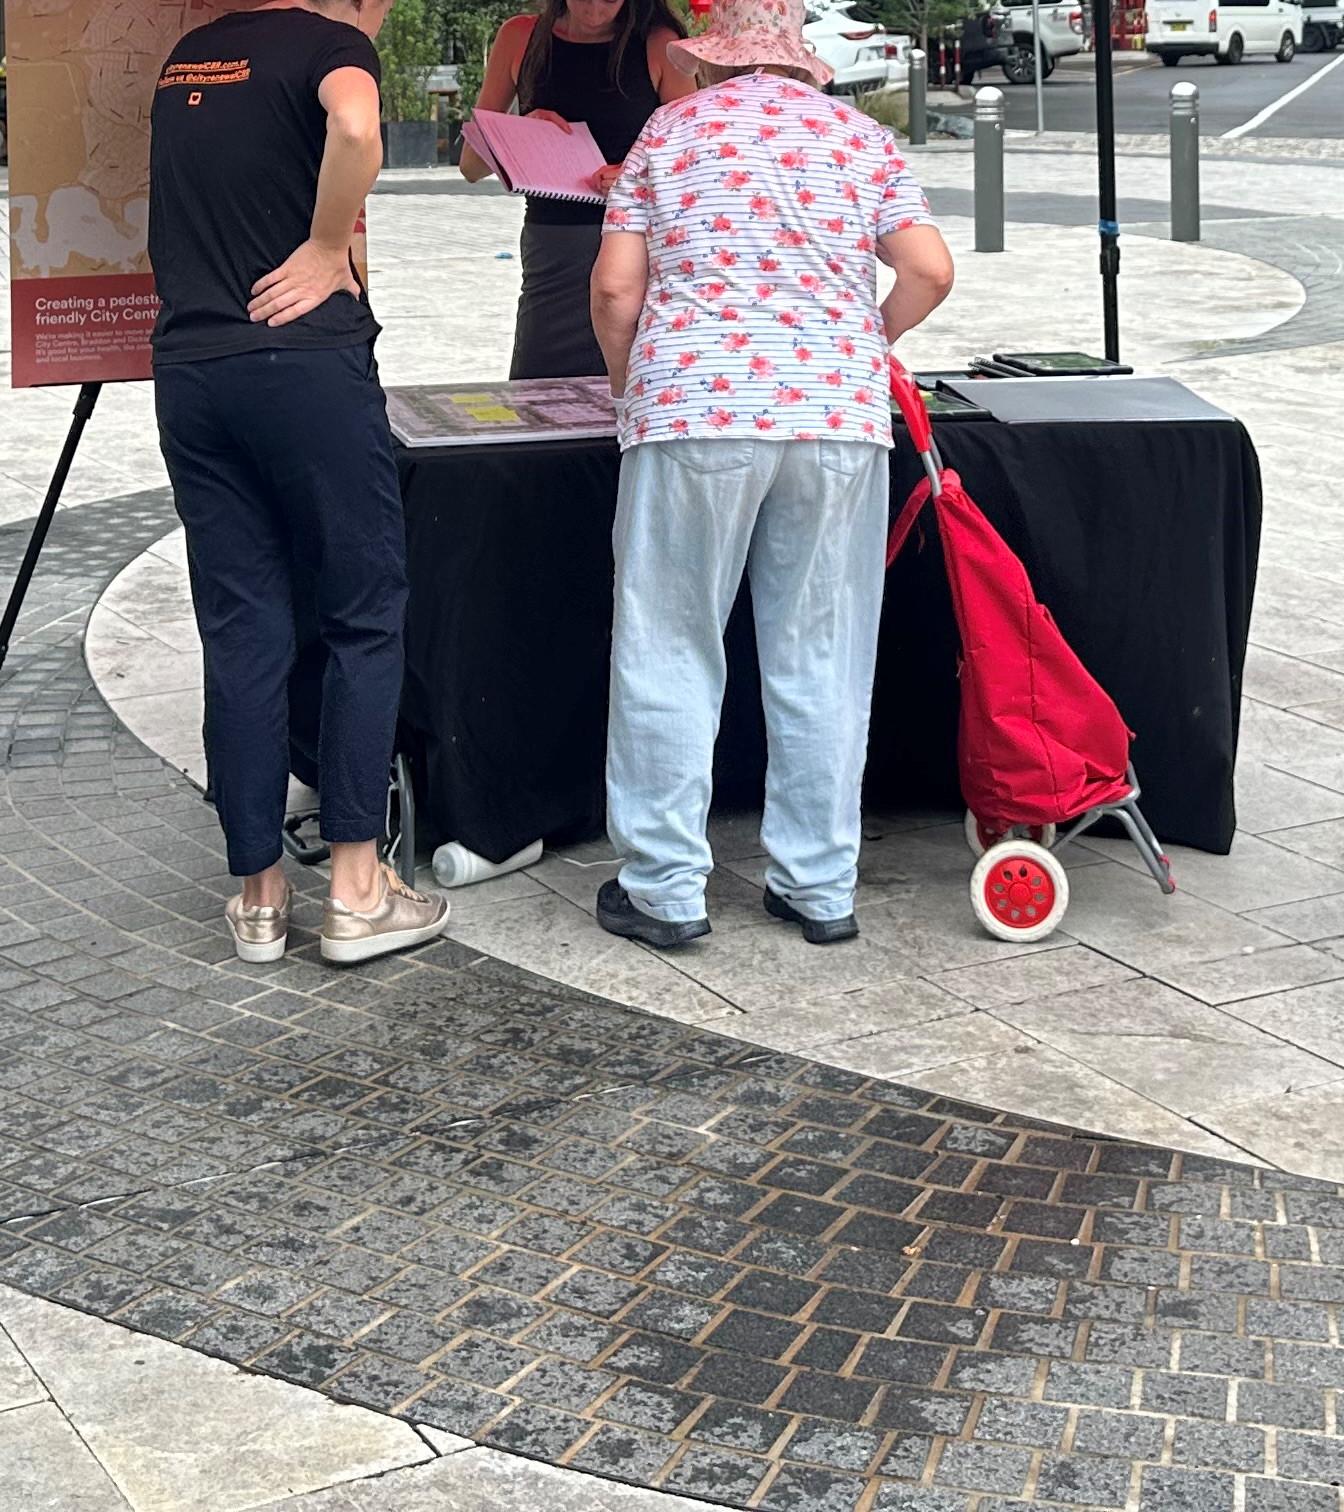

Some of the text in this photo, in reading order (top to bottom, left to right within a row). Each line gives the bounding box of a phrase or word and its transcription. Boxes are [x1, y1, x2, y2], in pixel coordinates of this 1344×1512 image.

[36, 293, 163, 310] Creating a pedestr
[36, 311, 87, 326] friendly
[90, 309, 119, 324] City
